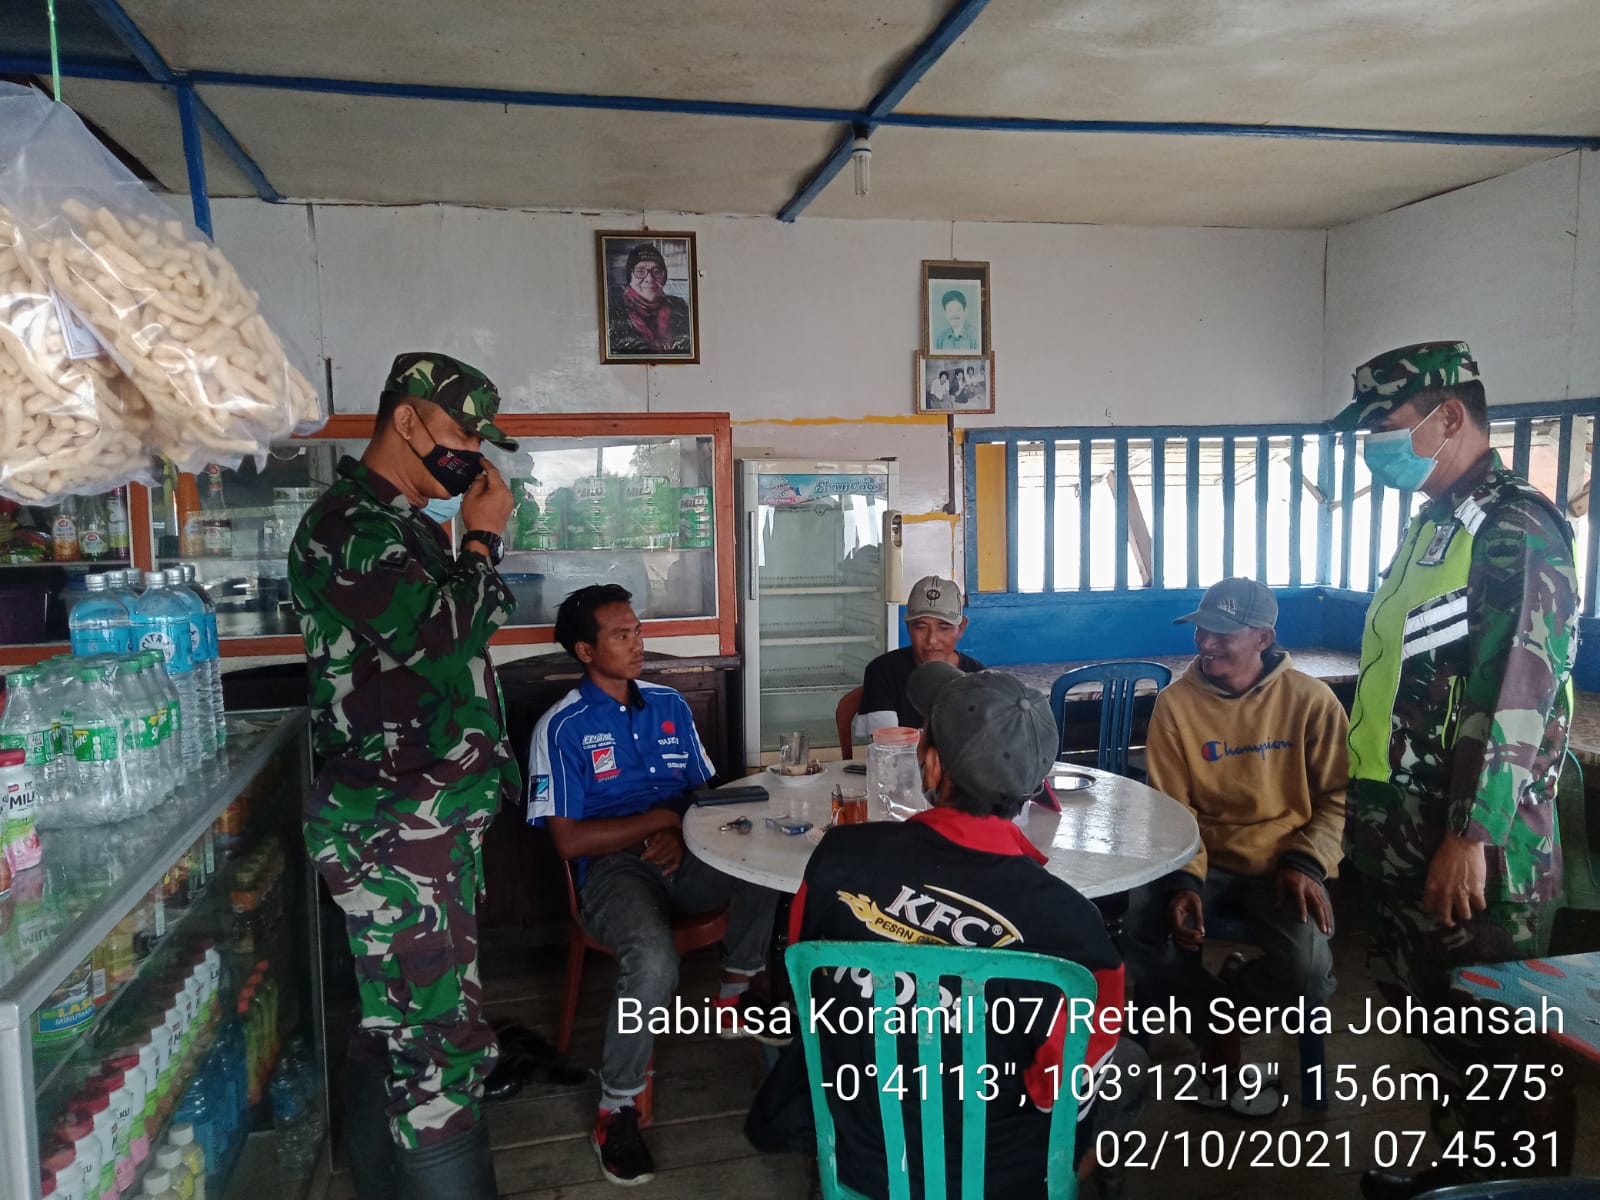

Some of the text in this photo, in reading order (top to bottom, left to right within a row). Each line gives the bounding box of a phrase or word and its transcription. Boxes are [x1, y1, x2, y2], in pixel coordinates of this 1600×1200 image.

[1202, 737, 1294, 761] Champion
[885, 884, 990, 947] KFC
[874, 917, 914, 941] PESAN
